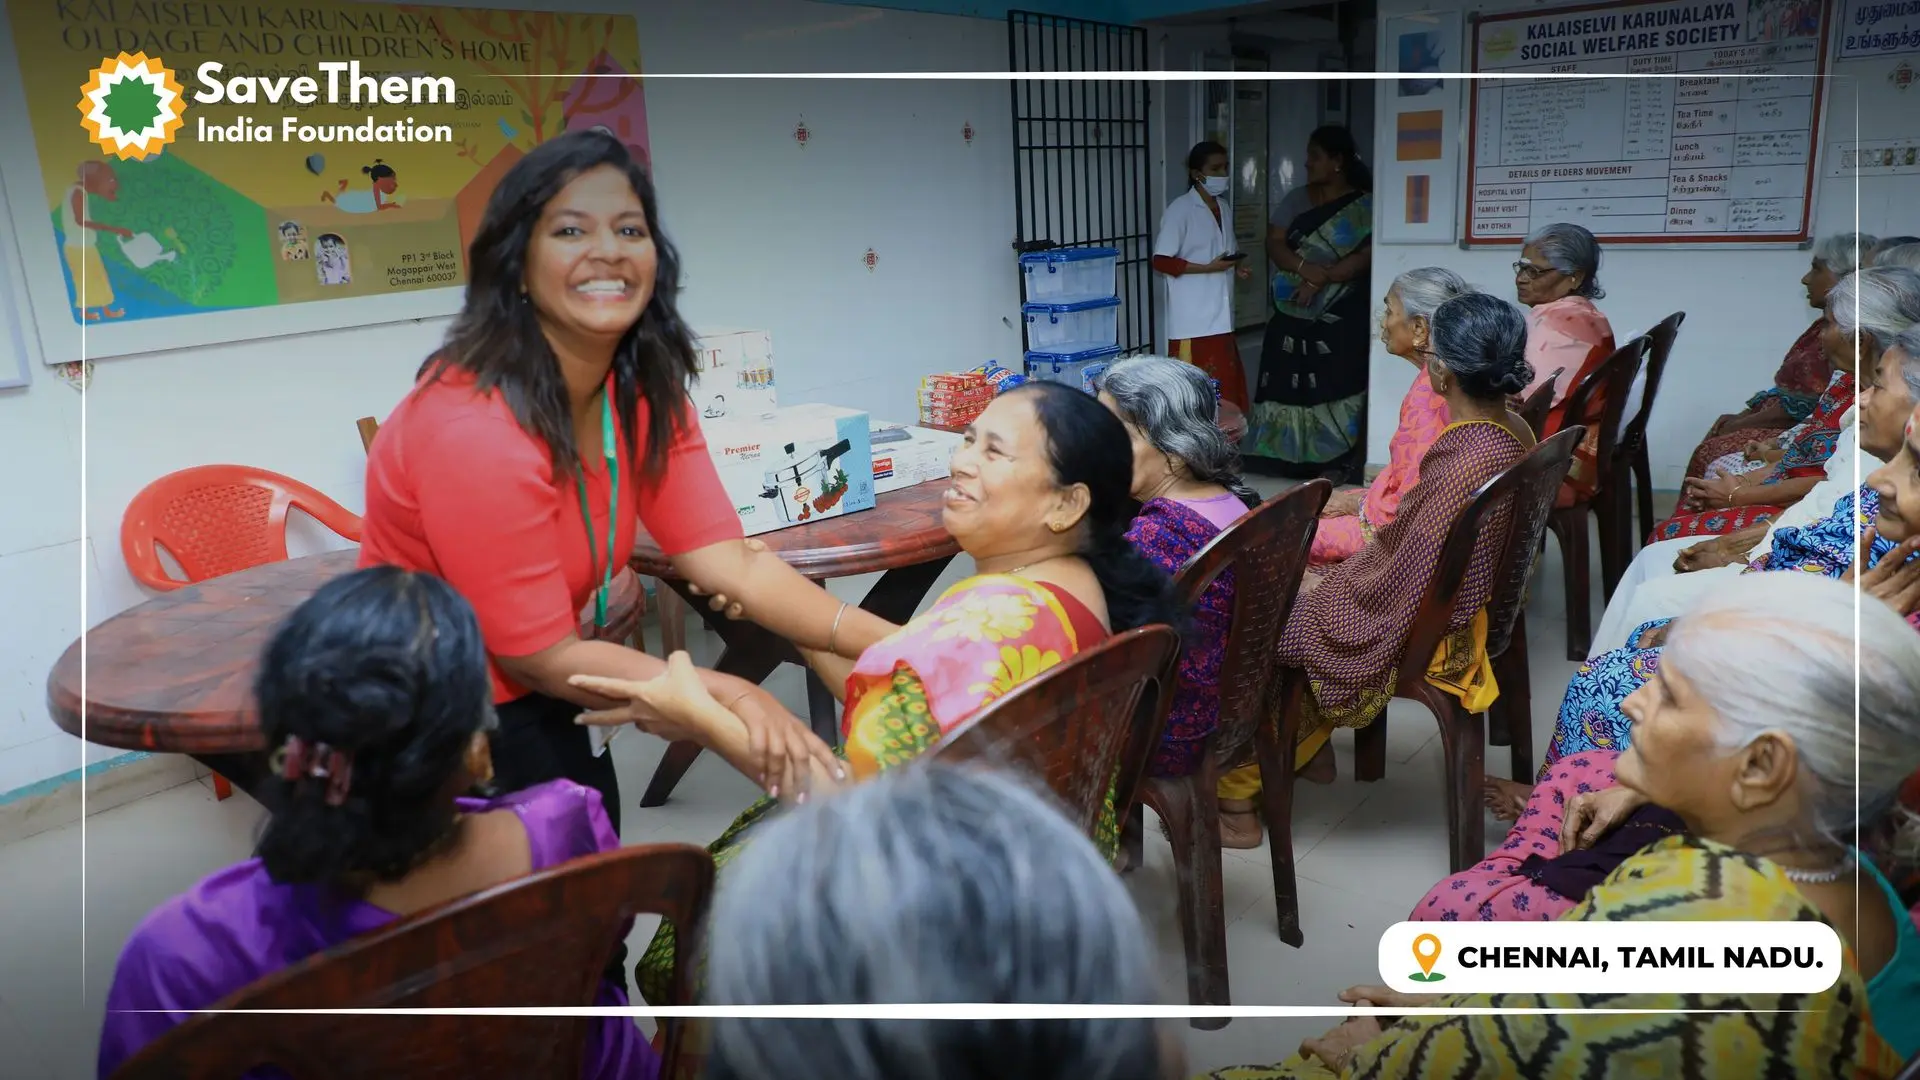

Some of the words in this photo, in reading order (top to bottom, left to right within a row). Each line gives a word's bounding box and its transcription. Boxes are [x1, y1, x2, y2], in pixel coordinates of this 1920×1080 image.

[257, 5, 441, 35] KARUNALAYA
[1528, 16, 1615, 40] KALAISELVI
[1622, 3, 1736, 33] KARUNALAYA
[217, 32, 285, 56] AND
[293, 33, 454, 60] CHILDREN'S
[461, 40, 533, 64] HOME
[1520, 37, 1577, 61] SOCIAL
[1582, 30, 1660, 56] WELFARE
[1665, 24, 1741, 49] SOCIETY
[1713, 47, 1745, 59] TODAY'S
[1632, 57, 1652, 67] DUTY
[1653, 55, 1672, 64] TIME
[1551, 63, 1578, 73] STAFF
[1679, 77, 1720, 87] Breakfast
[1677, 110, 1691, 118] Tea
[1693, 109, 1714, 117] Time
[1674, 142, 1700, 151] Lunch
[1508, 167, 1539, 179] DETAILS
[1541, 168, 1551, 177] OF
[1553, 166, 1584, 177] ELDERS
[1586, 165, 1633, 176] MOVEMENT
[1672, 174, 1687, 183] Tea
[1688, 174, 1695, 182] &
[1698, 173, 1728, 182] Snacks
[1478, 188, 1508, 197] HOSPITAL
[1477, 205, 1500, 213] FAMILY
[1502, 205, 1518, 213] VISIT
[1670, 207, 1697, 215] Dinner
[1491, 222, 1512, 230] OTHER
[401, 254, 416, 263] PP1
[433, 250, 454, 260] Block
[387, 263, 433, 277] Mogappair
[436, 262, 456, 271] West
[389, 275, 424, 286] Chennai
[427, 271, 456, 283] 600037
[724, 443, 761, 456] Premier
